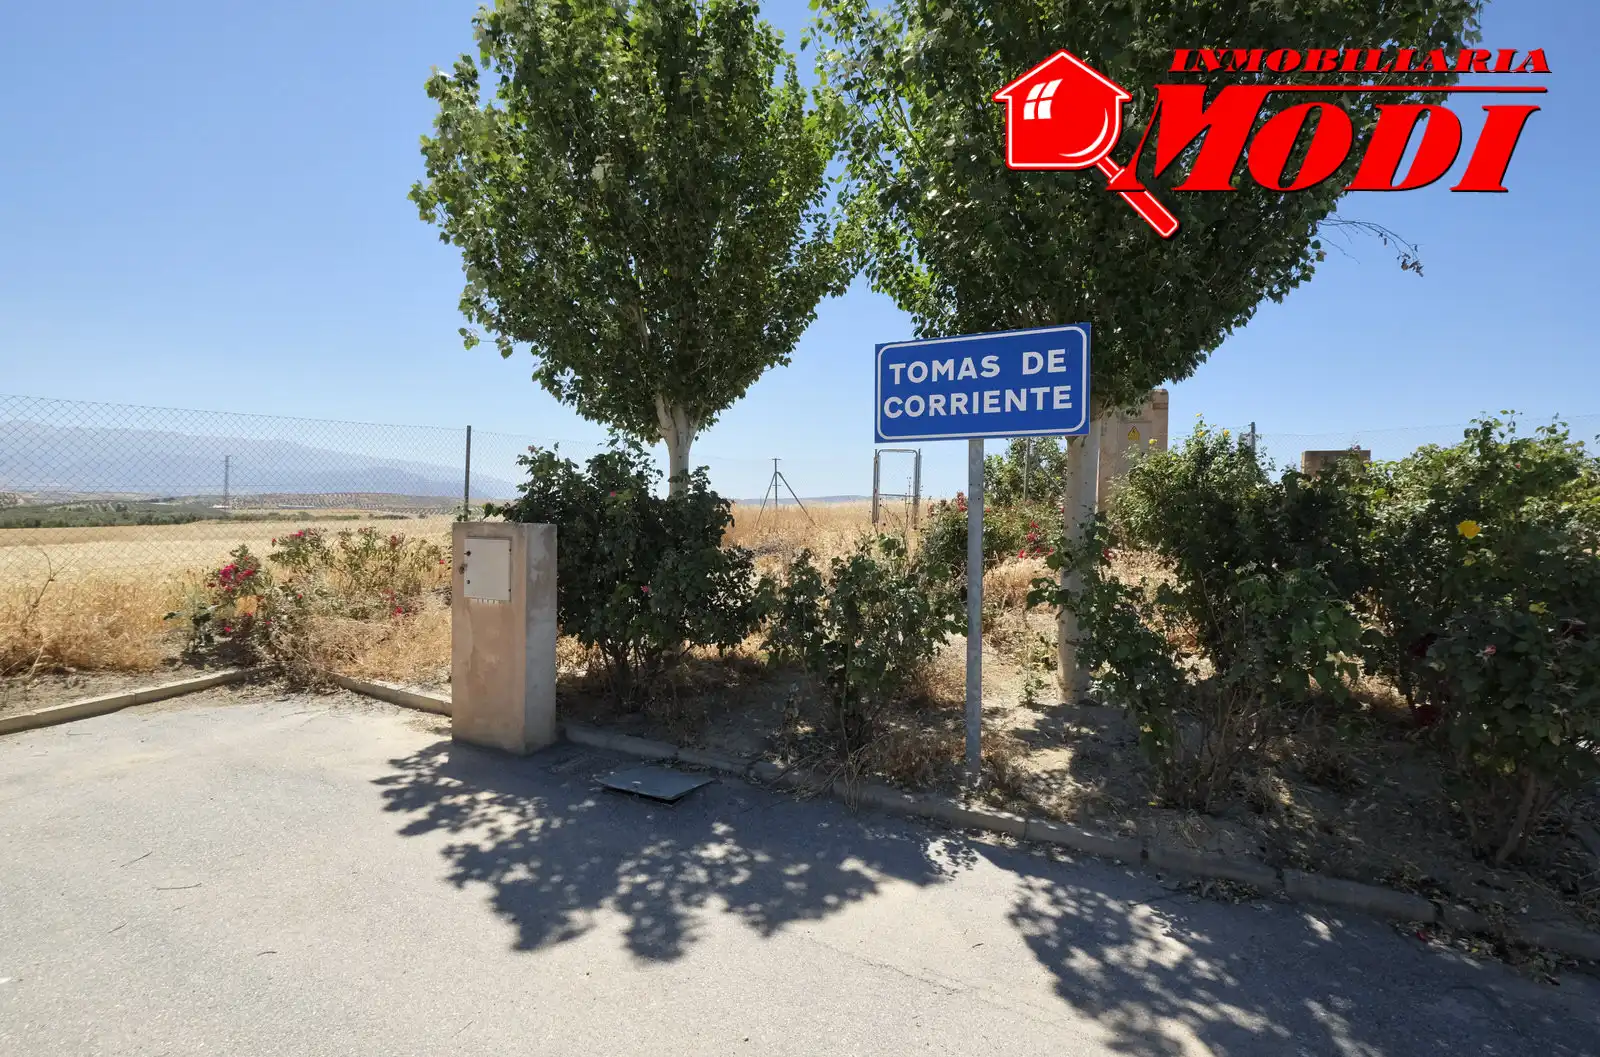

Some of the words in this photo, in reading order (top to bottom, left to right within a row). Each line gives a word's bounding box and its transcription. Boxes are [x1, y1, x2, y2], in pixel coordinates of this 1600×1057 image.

[888, 355, 1001, 385] TOMAS
[1022, 348, 1067, 375] DE
[883, 385, 1073, 419] CORRIENTE
